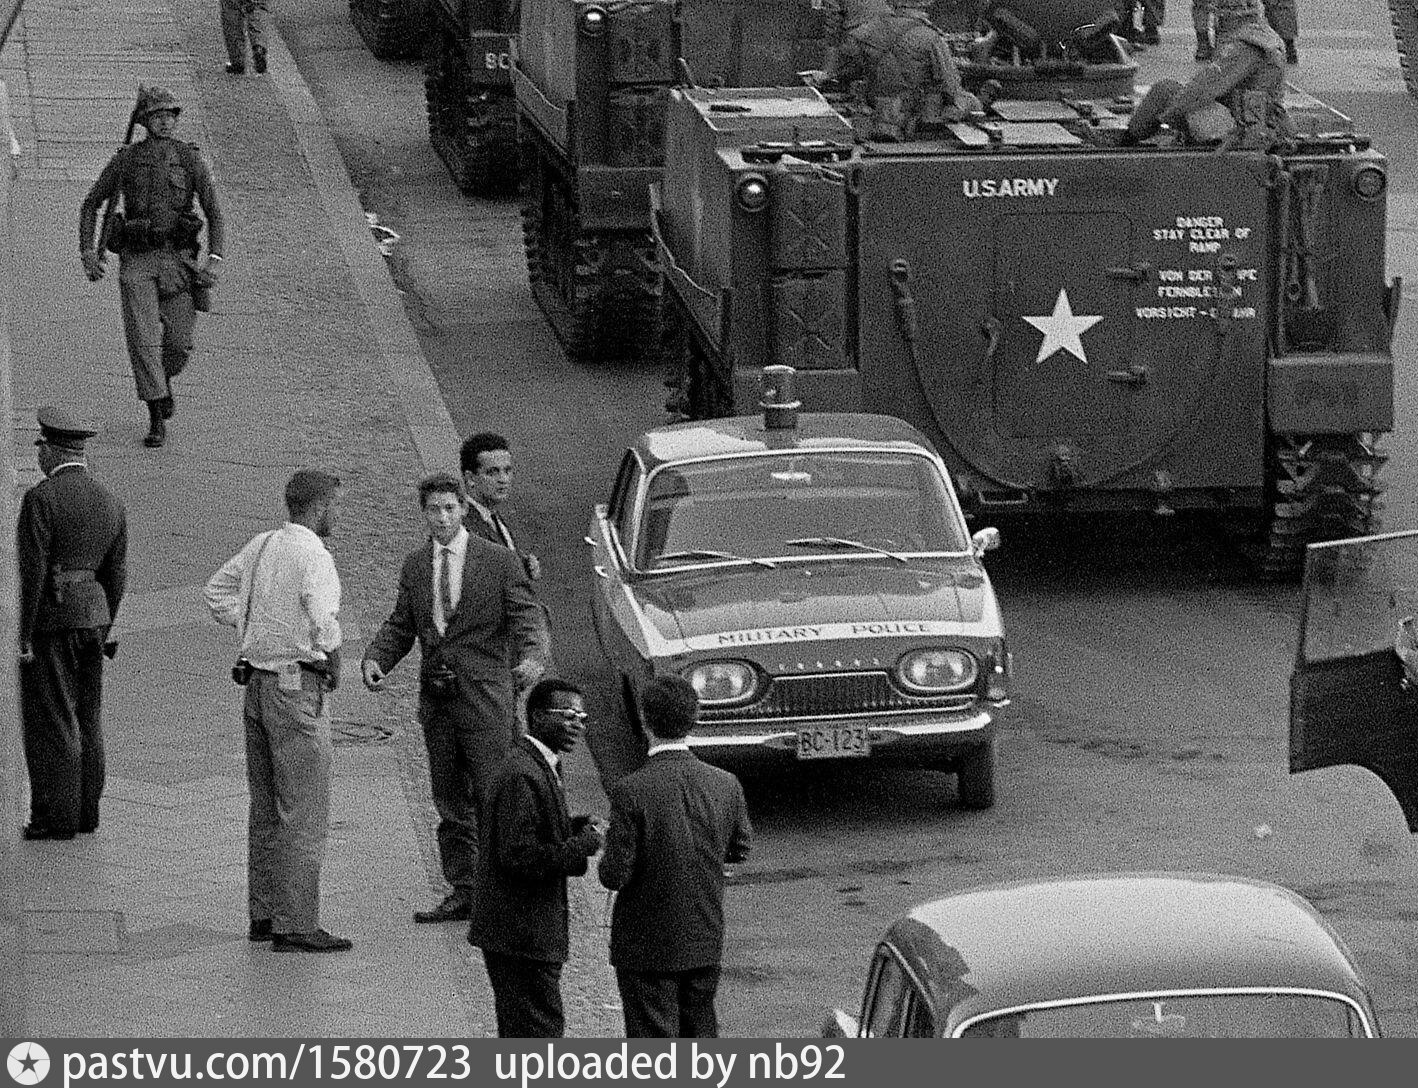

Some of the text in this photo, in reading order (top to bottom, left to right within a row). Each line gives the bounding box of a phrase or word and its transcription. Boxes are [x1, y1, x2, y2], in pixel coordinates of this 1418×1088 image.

[1175, 216, 1224, 228] DANGER
[1152, 227, 1251, 240] STAY CLEAR OF
[1188, 241, 1221, 253] RAMP
[1158, 269, 1183, 281] VON
[1187, 269, 1213, 281] DER
[1135, 307, 1197, 318] VORSICHT
[717, 623, 930, 645] MILITARY POLICE
[801, 729, 864, 753] BC-123
